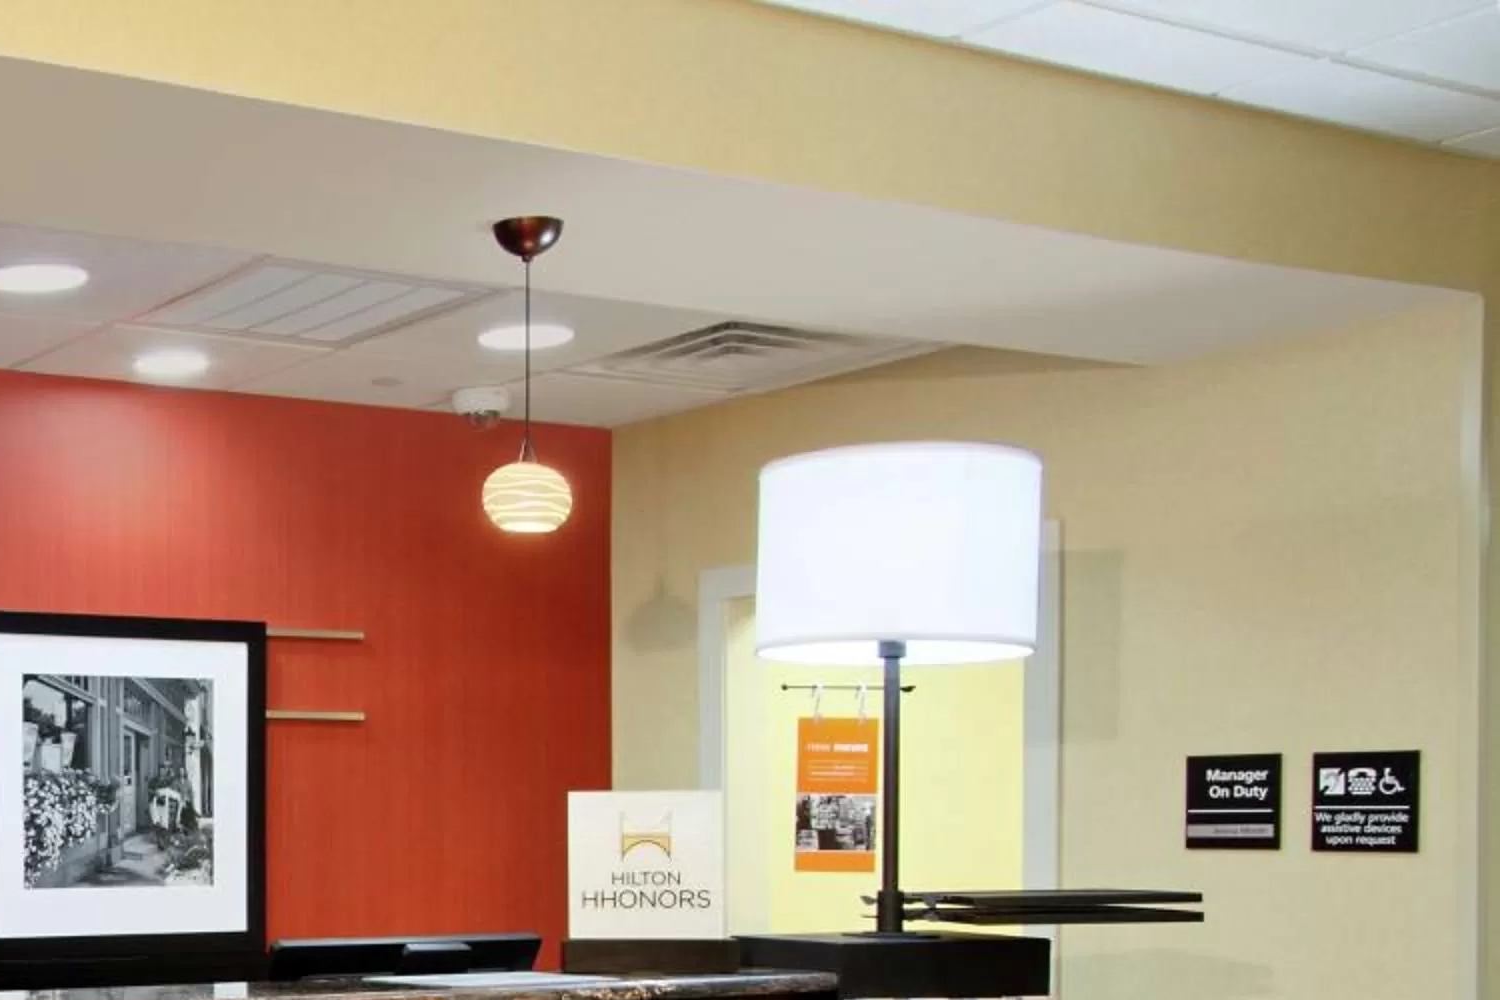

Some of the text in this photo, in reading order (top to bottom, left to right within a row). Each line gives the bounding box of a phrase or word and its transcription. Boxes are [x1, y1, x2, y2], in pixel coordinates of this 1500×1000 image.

[1205, 768, 1269, 784] Manager
[1209, 785, 1269, 800] On Duty
[611, 871, 681, 885] HILTON
[581, 888, 712, 909] HHONORS
